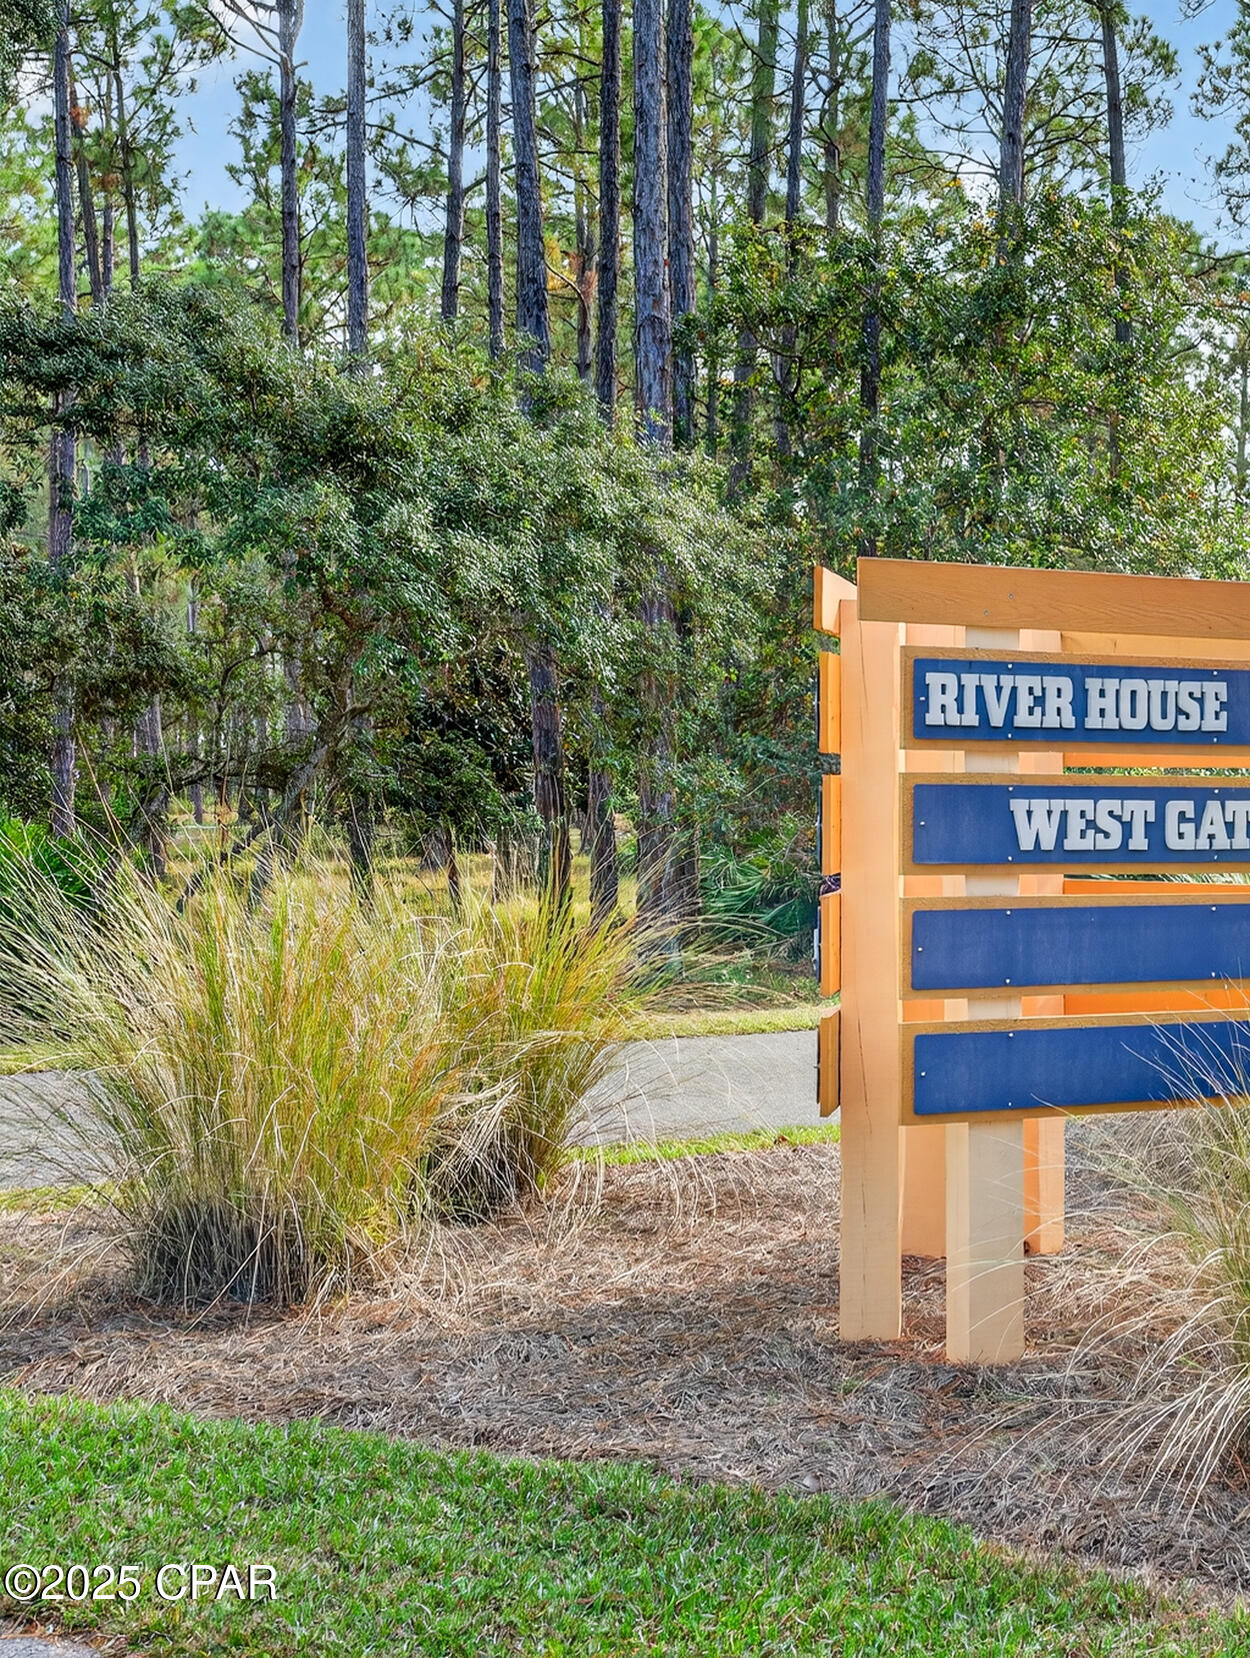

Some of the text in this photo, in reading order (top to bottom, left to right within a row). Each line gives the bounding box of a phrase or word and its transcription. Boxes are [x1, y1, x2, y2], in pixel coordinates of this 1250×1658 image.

[924, 672, 1228, 732] RIVER HOUSE
[1009, 798, 1155, 851] WEST
